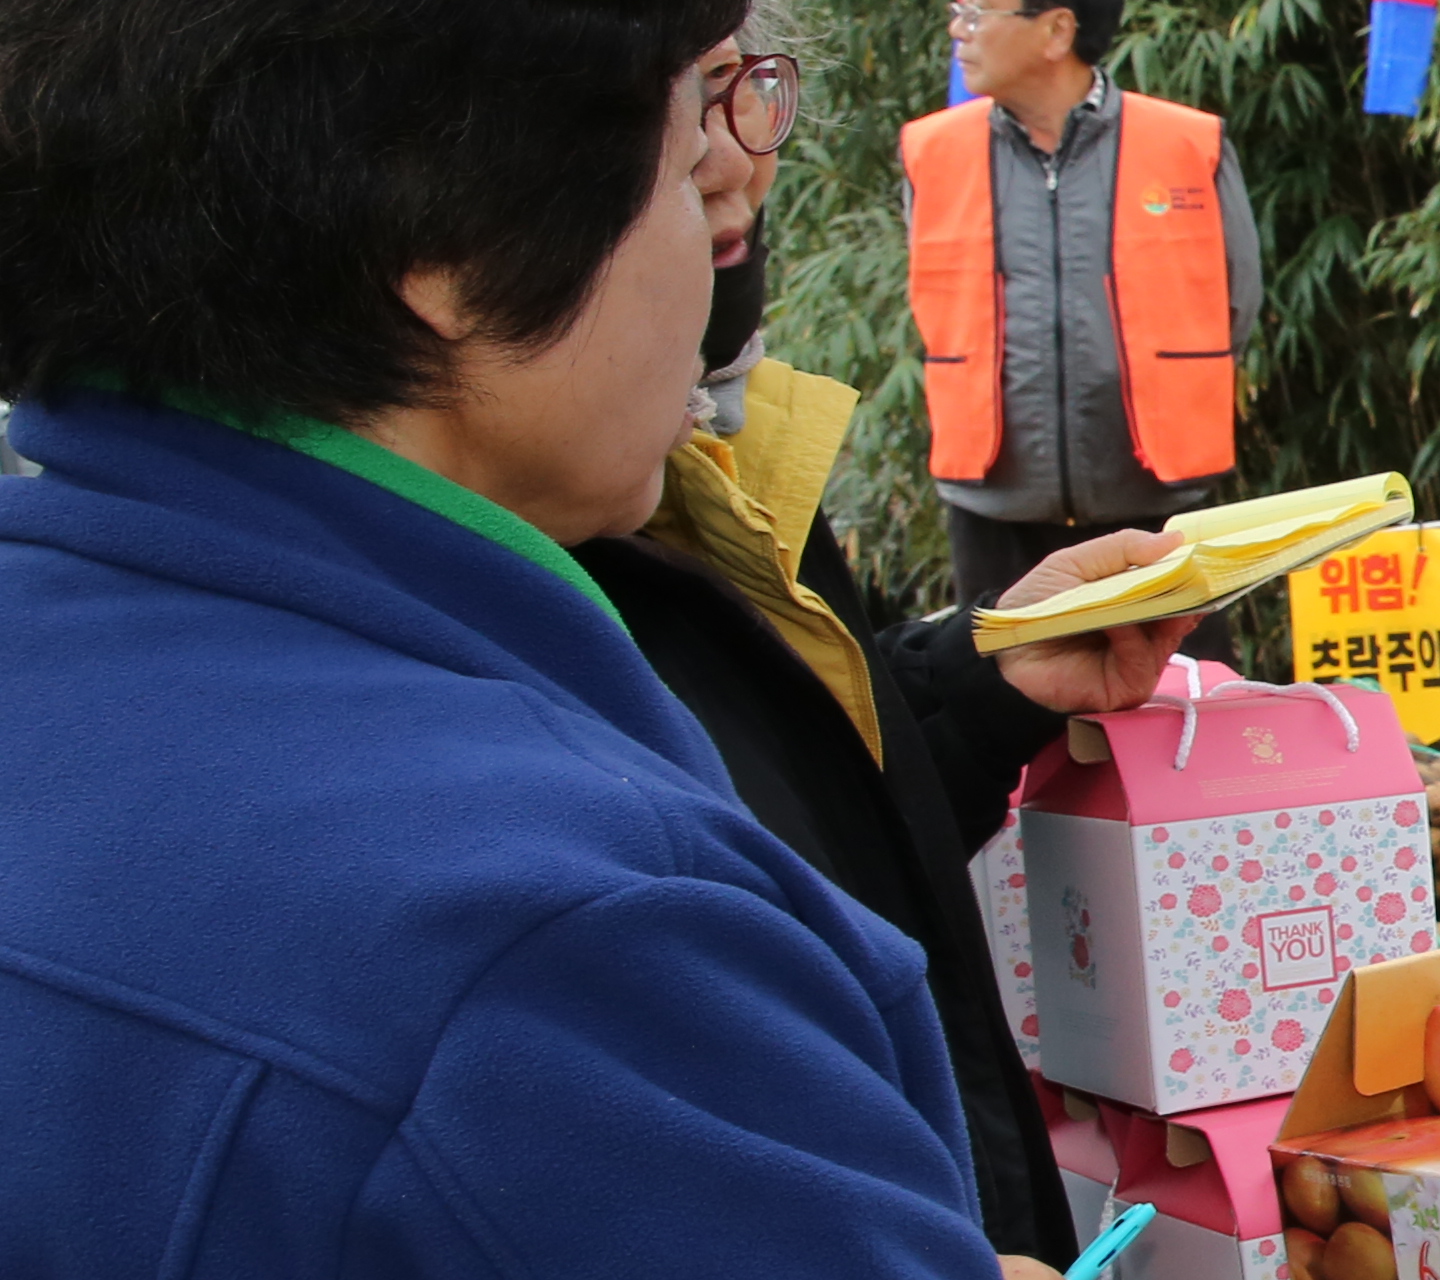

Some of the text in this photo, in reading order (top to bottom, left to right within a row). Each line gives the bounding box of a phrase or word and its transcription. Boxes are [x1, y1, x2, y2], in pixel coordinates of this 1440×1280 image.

[1320, 552, 1428, 614] 위험!
[1268, 921, 1324, 941] THANK
[1269, 935, 1326, 962] YOU
